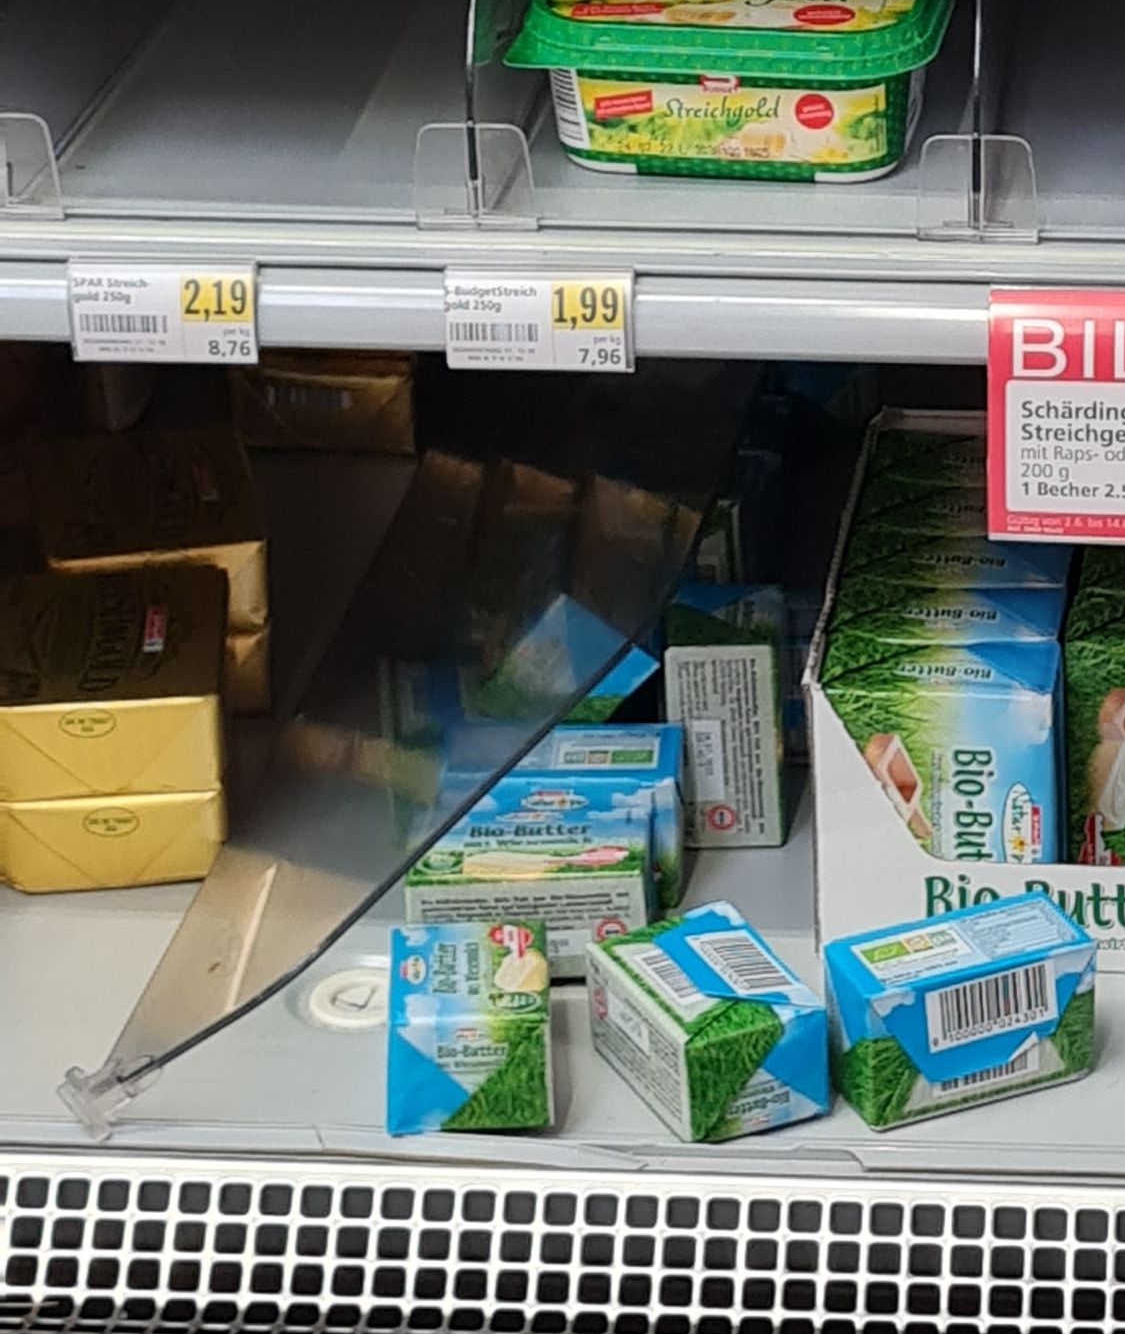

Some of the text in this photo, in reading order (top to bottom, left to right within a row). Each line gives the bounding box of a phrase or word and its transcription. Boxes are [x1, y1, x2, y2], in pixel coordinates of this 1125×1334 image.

[664, 96, 779, 120] Streichgold
[184, 279, 247, 320] 2,19
[553, 286, 618, 329] 1,99
[208, 341, 251, 357] 8,76
[579, 348, 621, 364] 7,96
[1020, 446, 1049, 461] mit
[1053, 446, 1099, 465] Raps-
[1020, 463, 1070, 482] 200 g
[1021, 482, 1030, 495] 1
[1037, 482, 1099, 498] Becher
[469, 820, 592, 841] Bio-Butter
